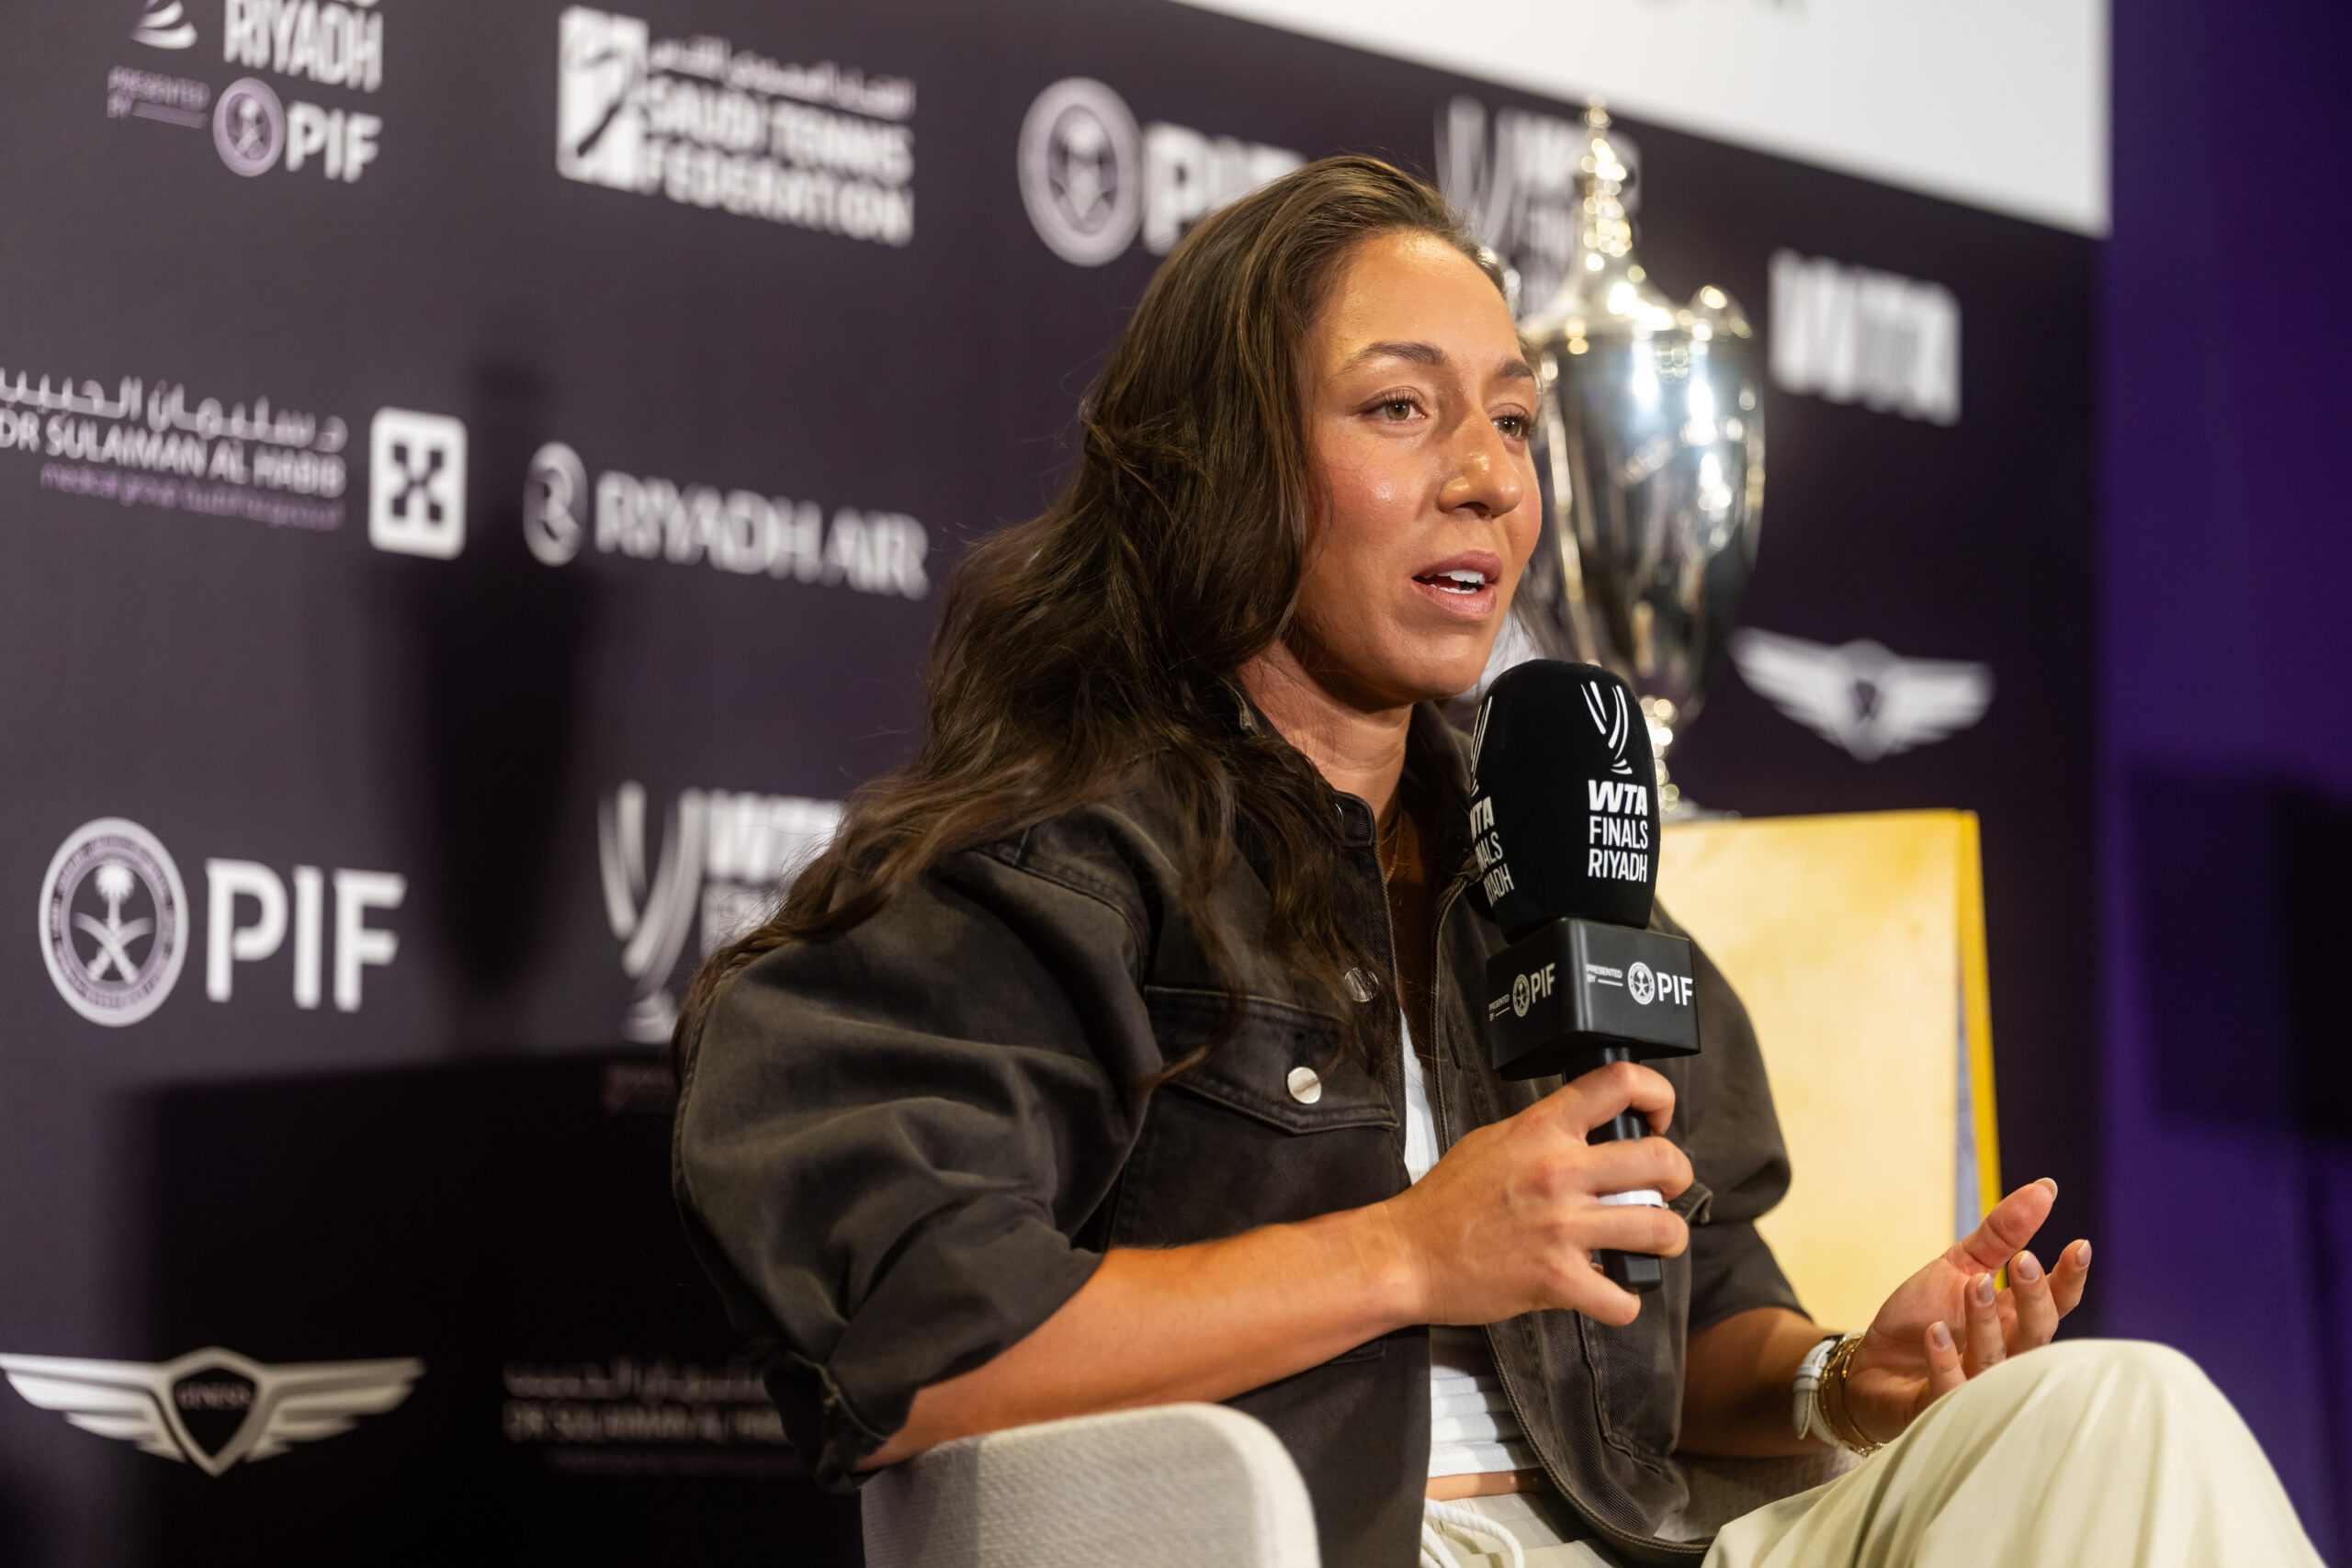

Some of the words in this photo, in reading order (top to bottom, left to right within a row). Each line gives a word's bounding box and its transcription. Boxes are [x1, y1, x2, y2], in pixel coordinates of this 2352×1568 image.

[223, 0, 383, 92] RIYADH
[286, 99, 381, 183] PIF
[0, 407, 40, 453] DR
[595, 470, 822, 585] RIYADH
[1588, 779, 1647, 817] WTA
[1475, 831, 1504, 874] NALS
[1589, 815, 1648, 850] FINALS
[1484, 863, 1515, 908] IYADH
[1588, 848, 1648, 883] RIYADH
[205, 857, 406, 1013] PIF
[1530, 962, 1555, 1004] PIF
[1657, 972, 1693, 1006] PIF
